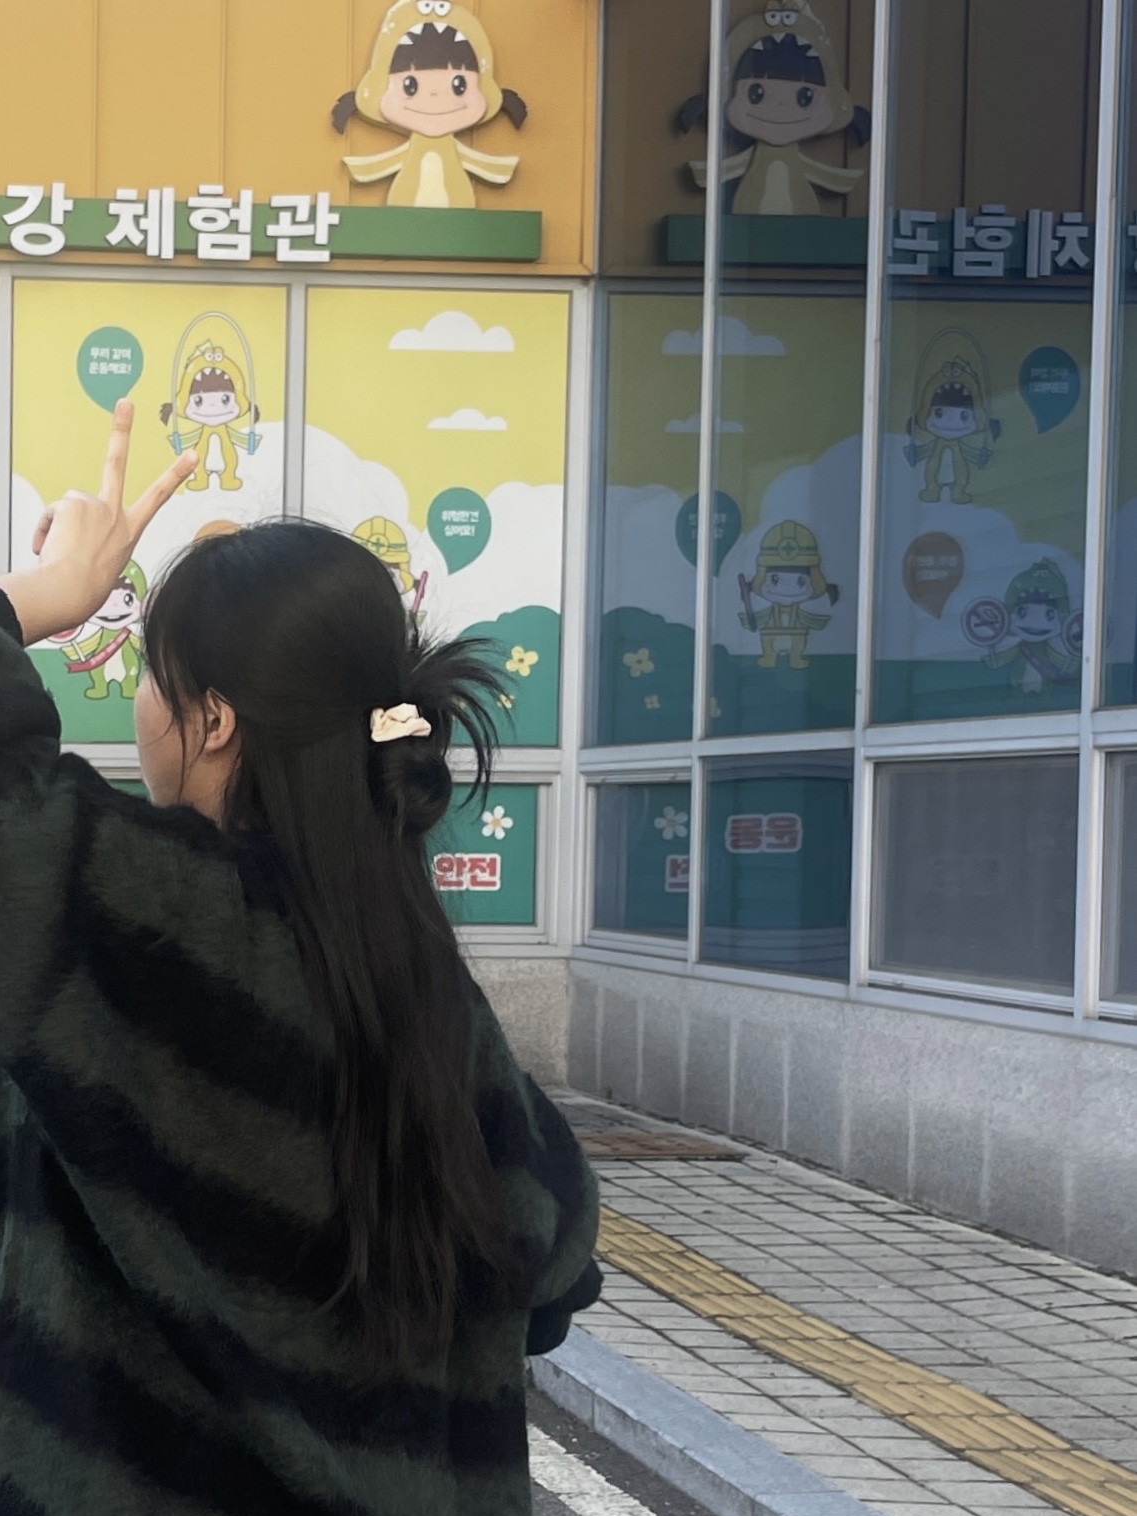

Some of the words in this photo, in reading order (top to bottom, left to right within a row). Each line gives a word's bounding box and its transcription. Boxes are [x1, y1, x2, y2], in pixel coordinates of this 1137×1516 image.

[106, 185, 340, 262] 체험관
[90, 347, 110, 360] 우리
[112, 348, 132, 360] 같이
[89, 362, 132, 375] 운동해요!
[432, 853, 501, 891] 안전
